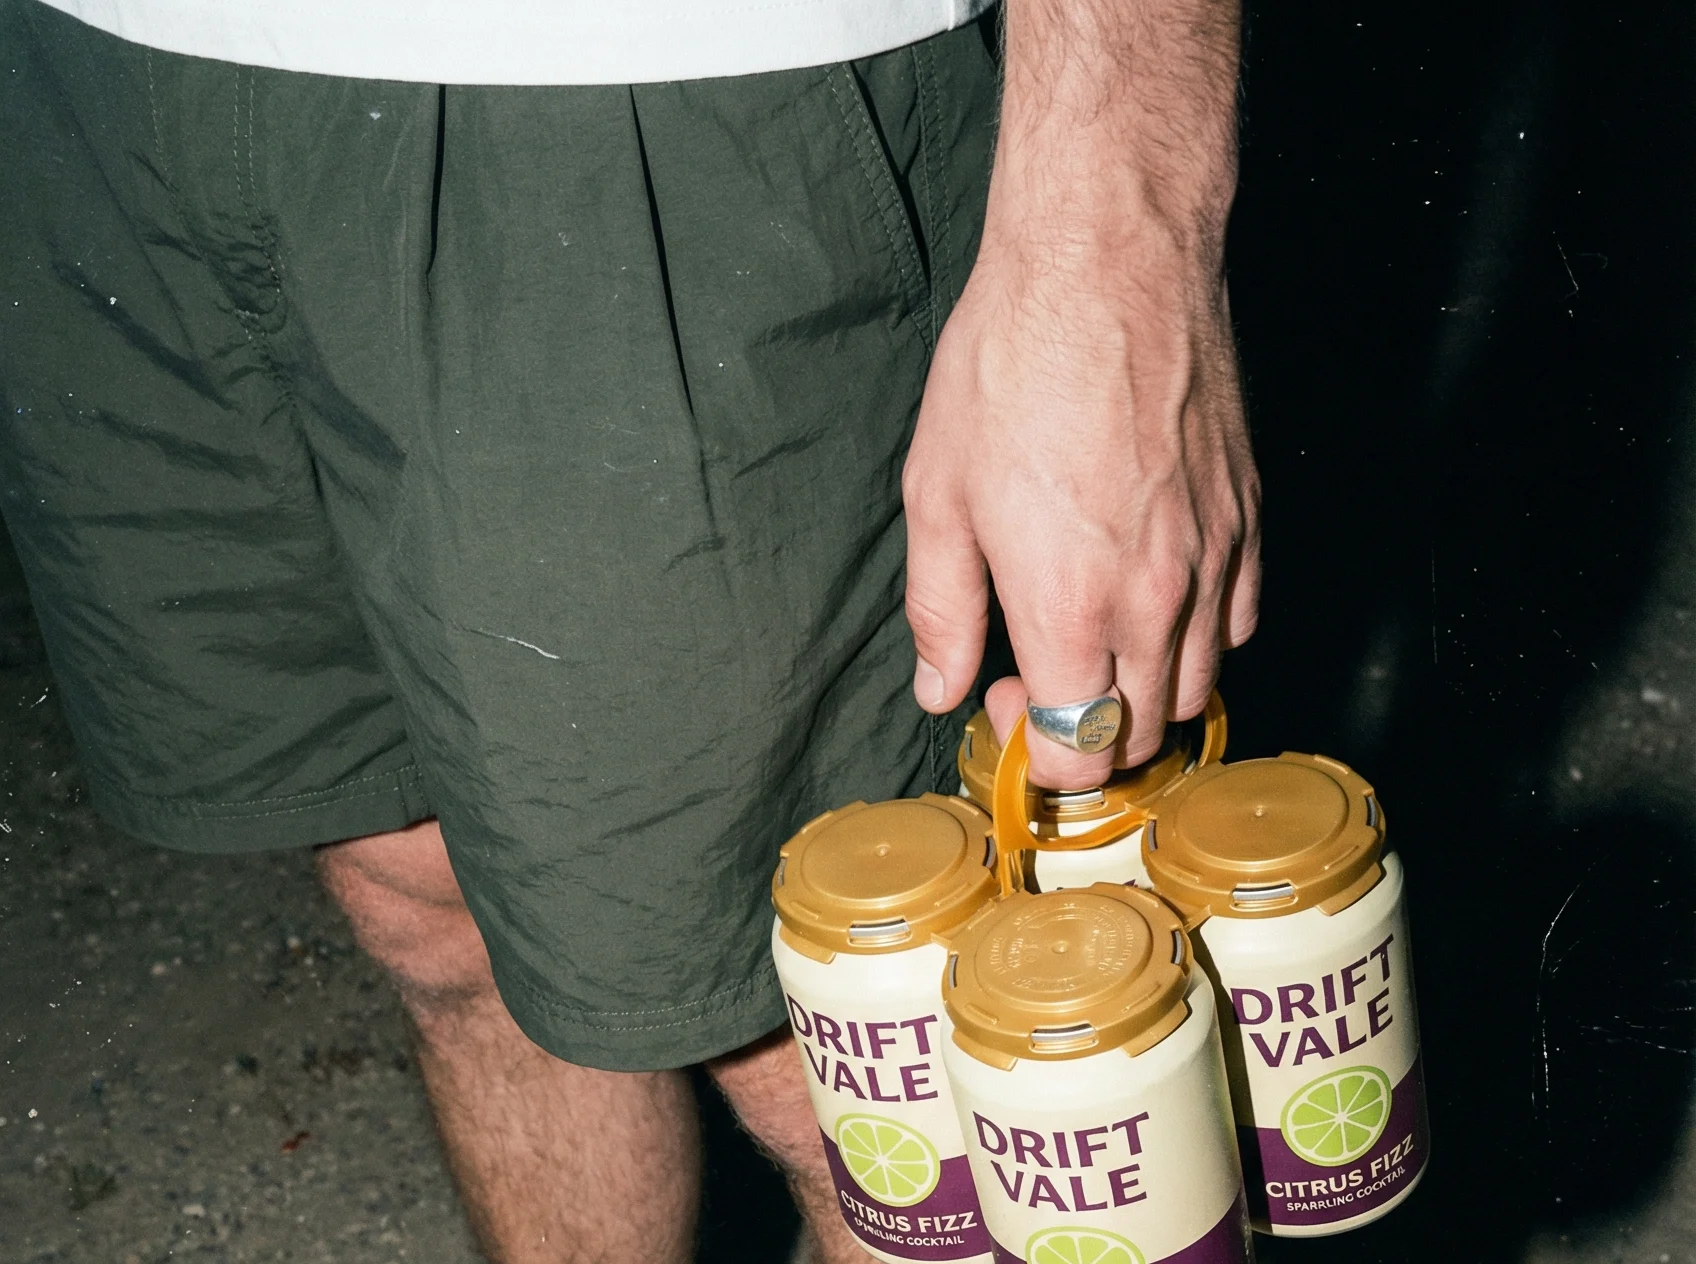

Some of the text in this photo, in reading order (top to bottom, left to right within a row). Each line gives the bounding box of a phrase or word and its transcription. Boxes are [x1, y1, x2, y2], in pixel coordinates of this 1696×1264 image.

[1230, 933, 1394, 1026] DRIFT
[787, 993, 938, 1060] DRIFT
[1249, 987, 1394, 1068] VALE
[803, 1042, 939, 1103] VALE
[973, 1110, 1150, 1169] DRIFT
[1265, 1133, 1414, 1198] CITRUS FIZZ
[840, 1189, 978, 1233] CITRUS FIZZ
[990, 1160, 1148, 1213] VALE
[906, 1235, 965, 1246] COCKTAIL
